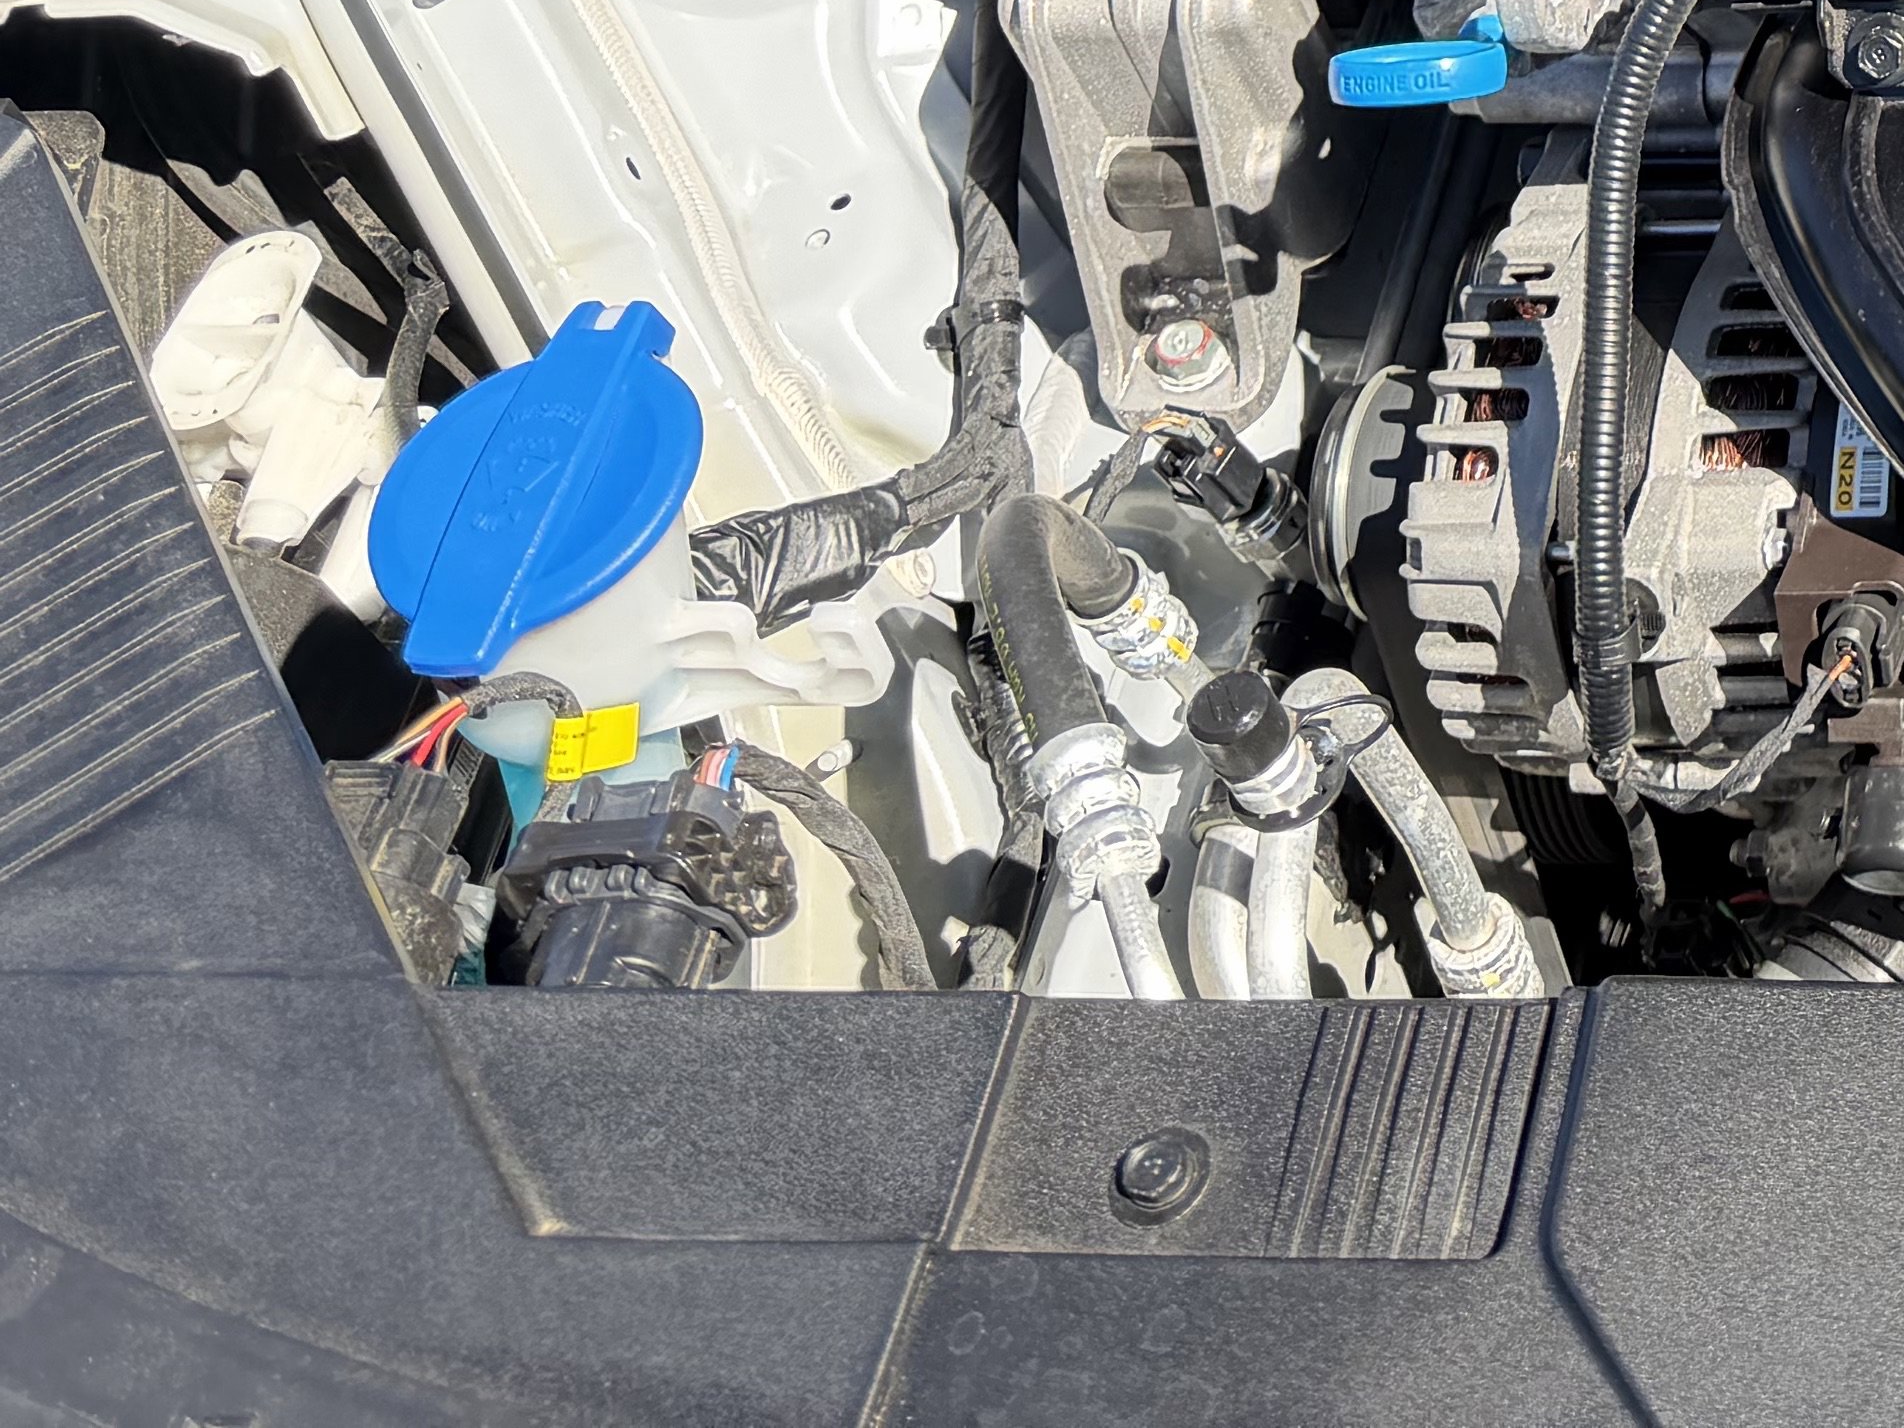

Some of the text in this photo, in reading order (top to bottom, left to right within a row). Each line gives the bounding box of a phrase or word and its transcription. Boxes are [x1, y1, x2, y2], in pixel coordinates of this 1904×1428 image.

[1341, 69, 1453, 98] ENGINE OIL
[1837, 449, 1857, 509] N20
